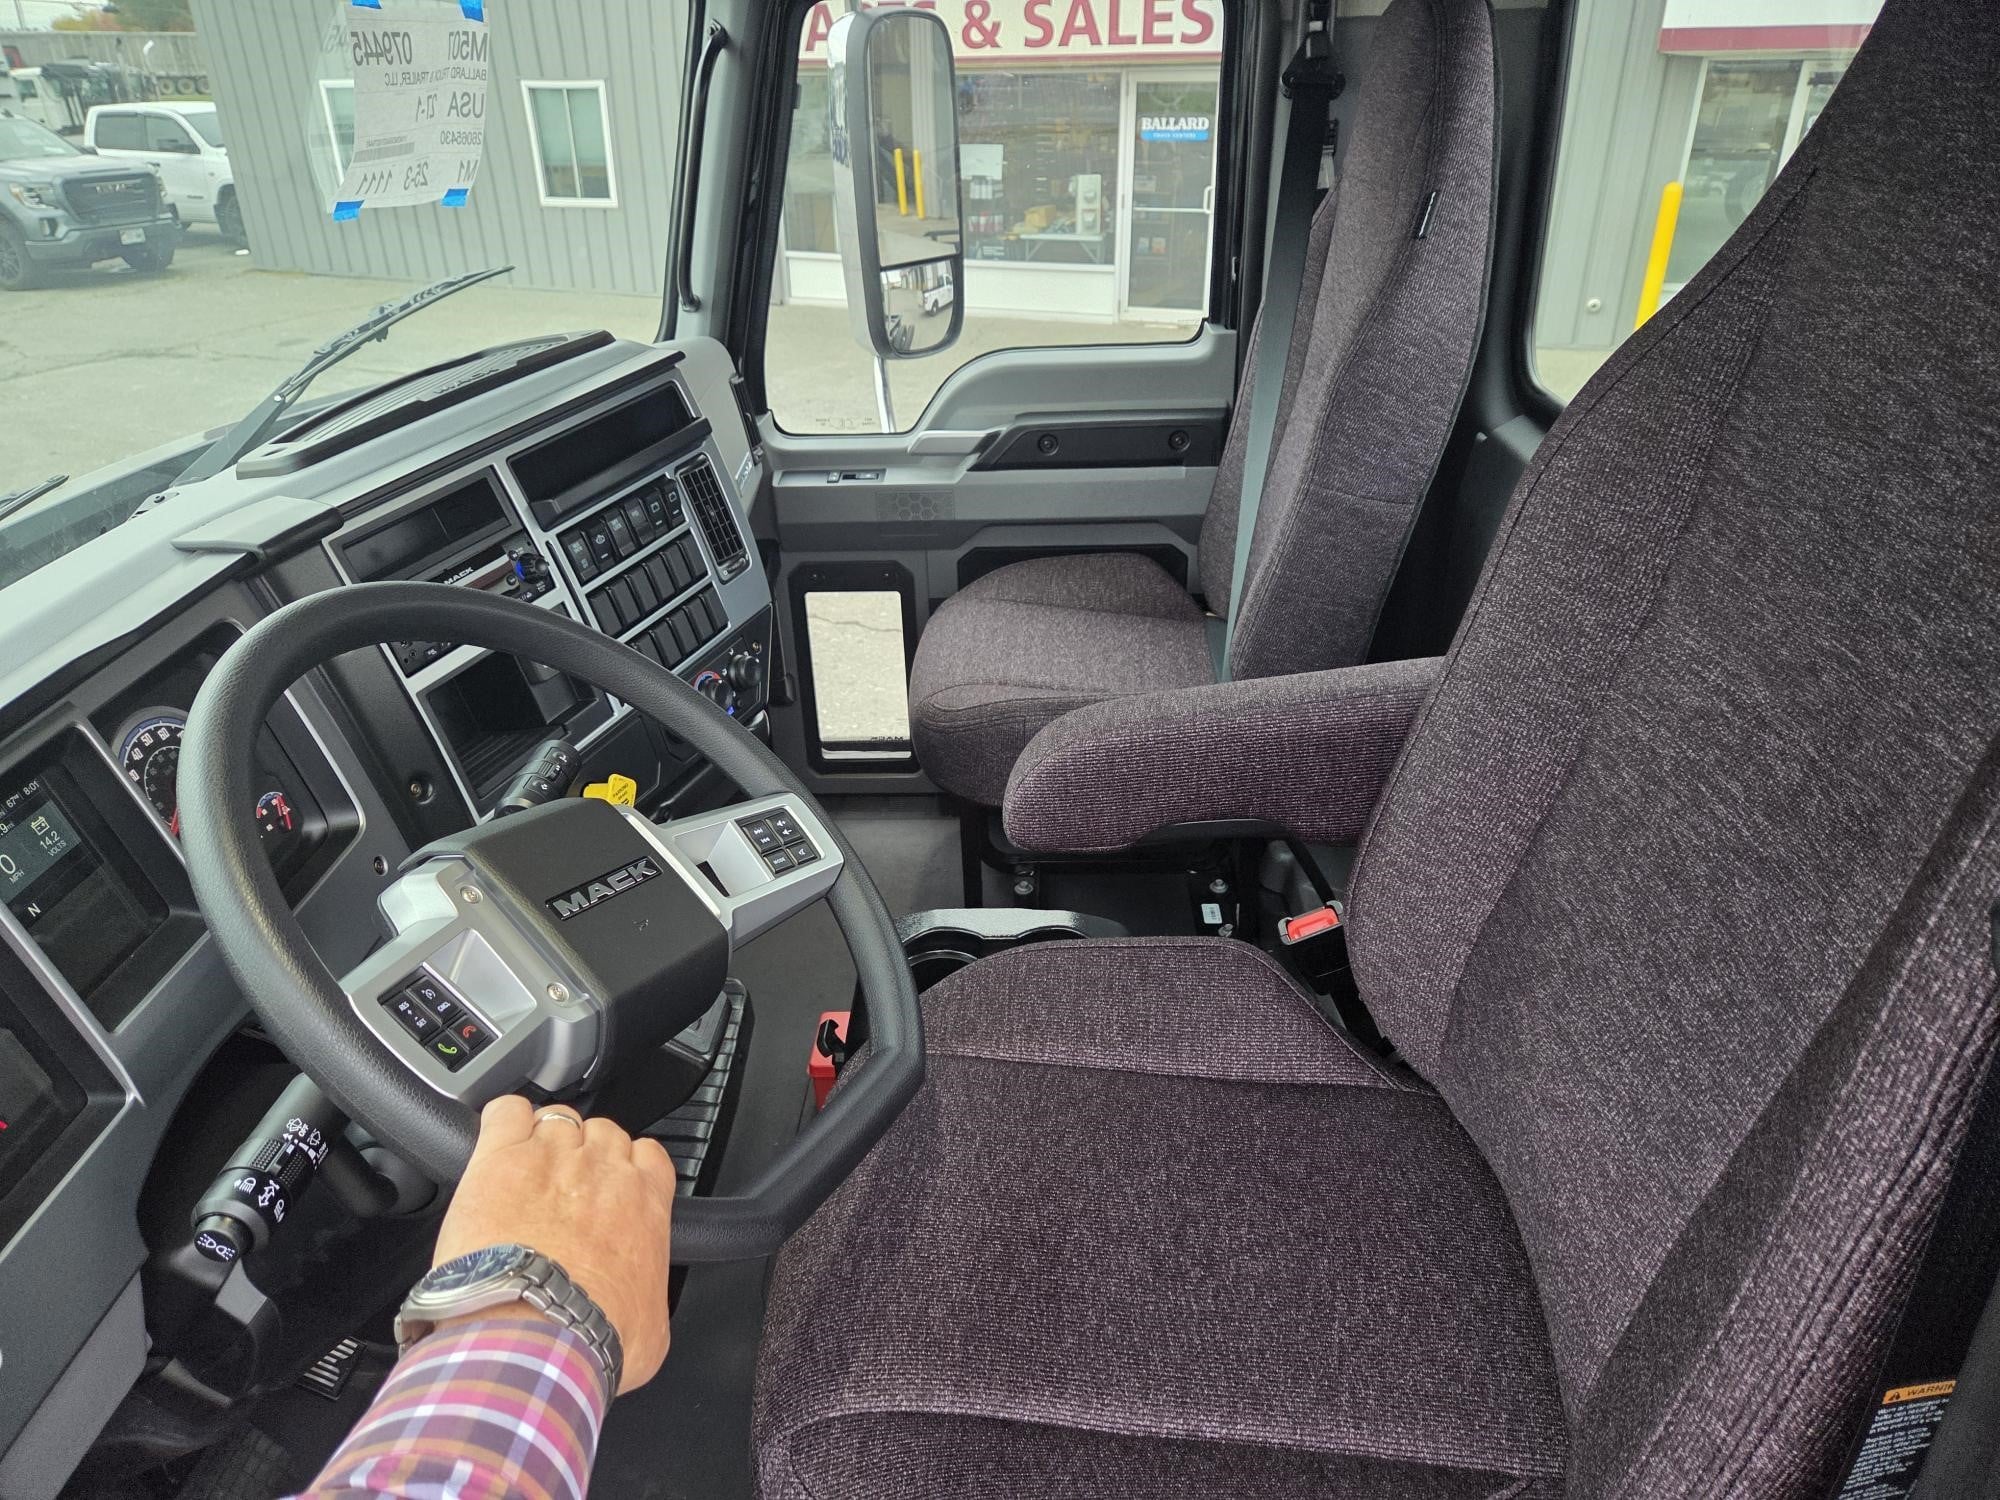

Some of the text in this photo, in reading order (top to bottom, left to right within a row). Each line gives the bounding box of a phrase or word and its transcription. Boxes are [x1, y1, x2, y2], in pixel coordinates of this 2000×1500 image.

[962, 0, 1001, 49] &
[1024, 0, 1214, 49] SALES
[1141, 116, 1209, 130] BALLARD
[443, 566, 474, 585] MACK
[141, 732, 154, 747] 50
[23, 780, 40, 796] 8:01
[40, 830, 60, 849] 14.2
[48, 840, 67, 857] VOLTS
[9, 869, 25, 884] MPH
[552, 860, 657, 917] MACK
[27, 902, 42, 917] N
[1907, 1383, 1955, 1397] WARNIN
